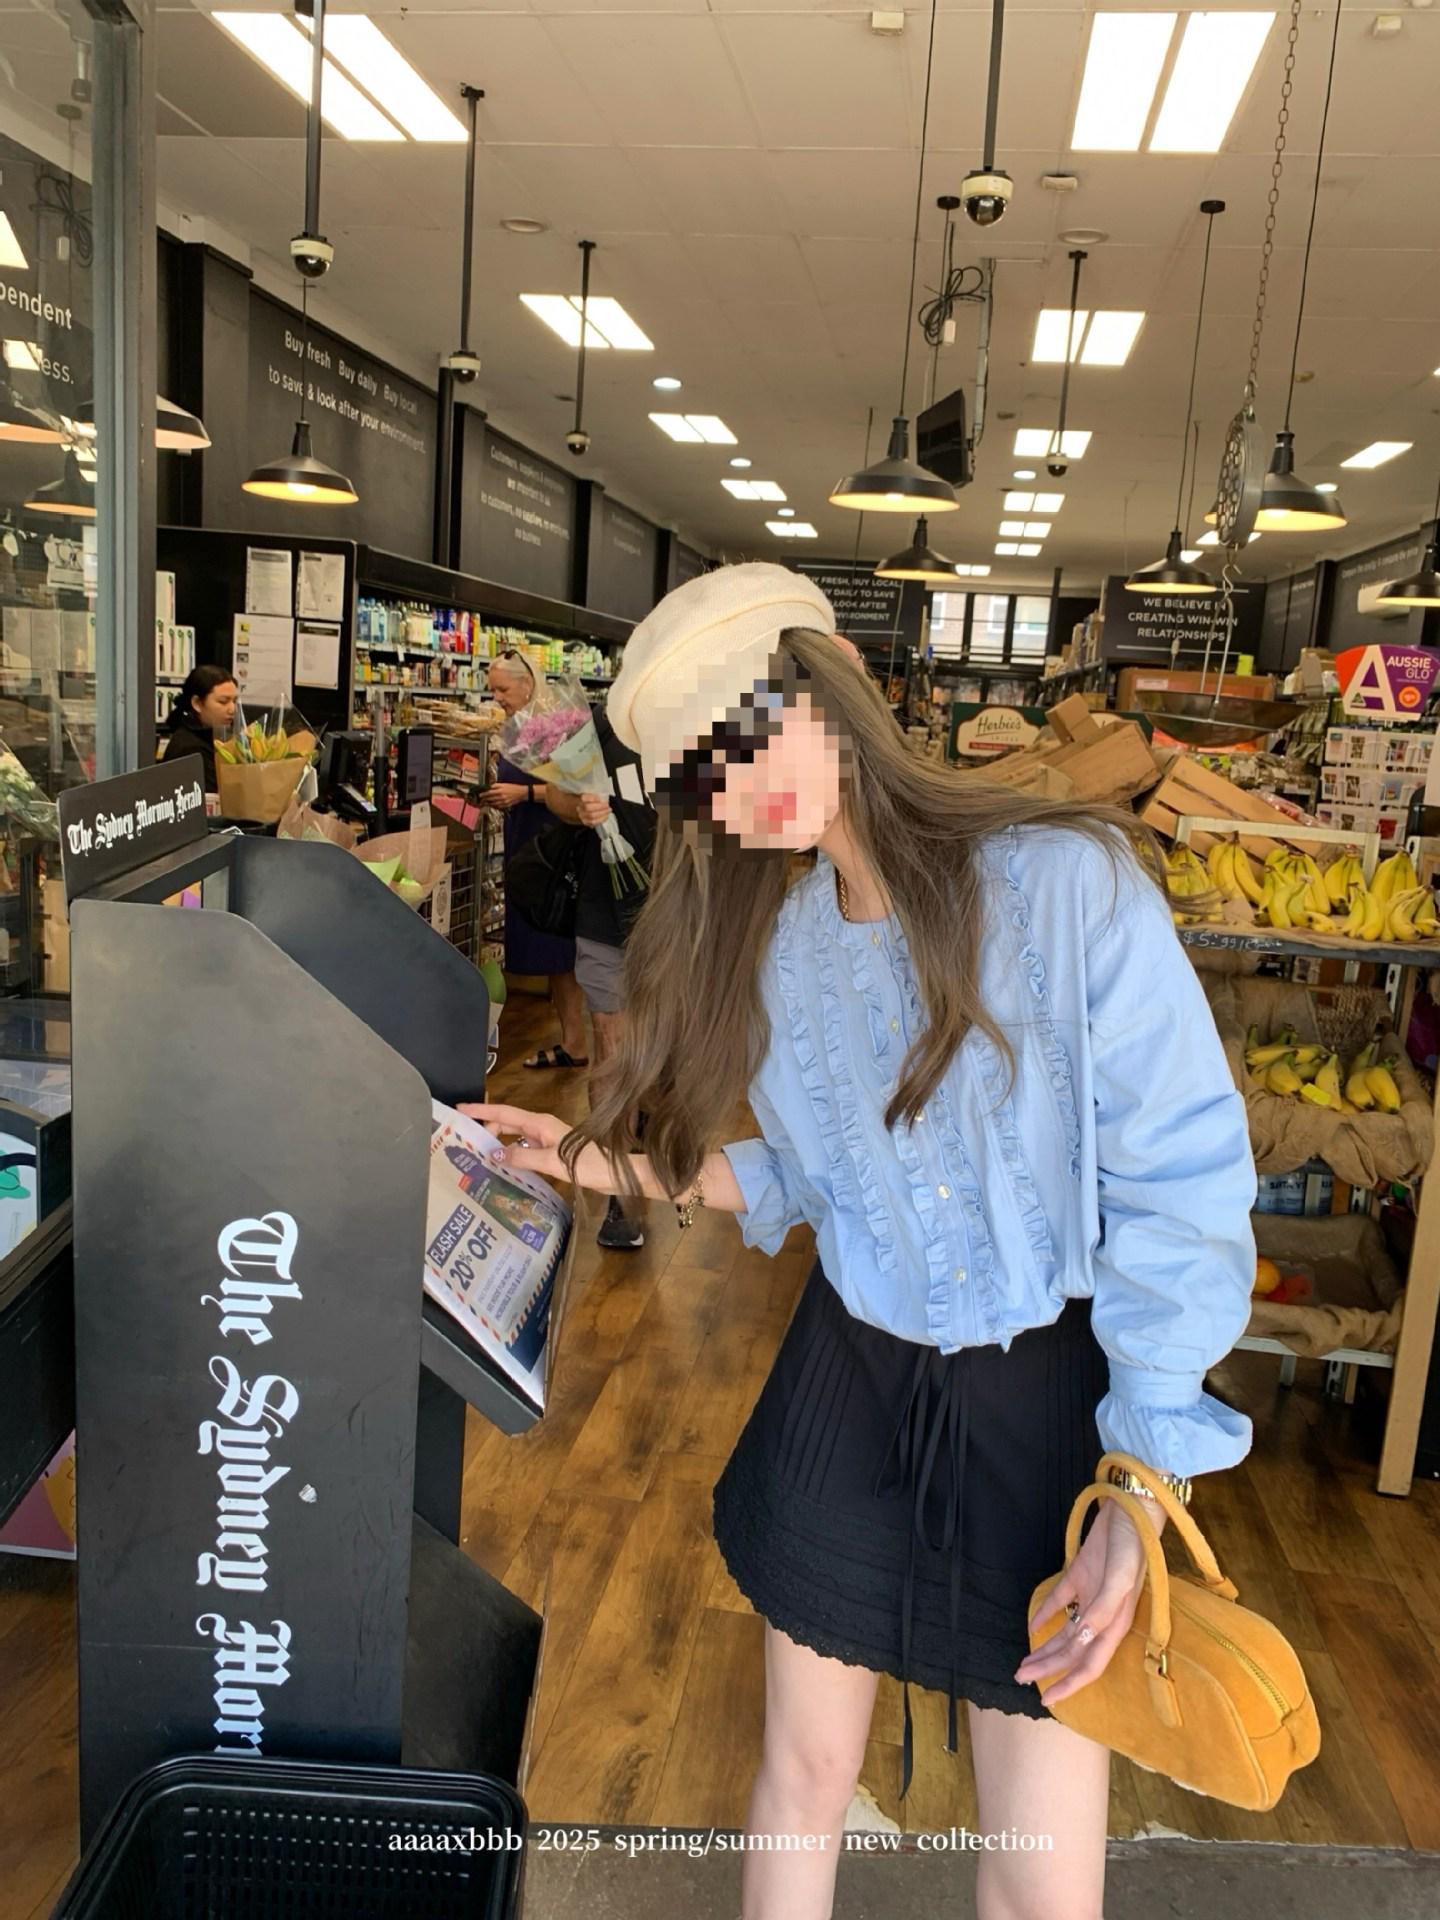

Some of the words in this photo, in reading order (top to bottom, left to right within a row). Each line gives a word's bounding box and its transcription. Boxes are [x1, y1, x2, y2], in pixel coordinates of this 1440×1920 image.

[284, 329, 304, 358] Buy
[307, 342, 332, 369] fresh
[338, 359, 356, 385] Buy
[357, 369, 378, 396] daily
[268, 364, 281, 385] to
[282, 374, 304, 398] save
[307, 383, 314, 402] &
[316, 386, 337, 412] look
[338, 399, 360, 422] after
[360, 411, 380, 432] your
[859, 601, 888, 609] AFTER
[873, 590, 896, 599] SAVE
[1143, 597, 1162, 607] WE
[1165, 598, 1212, 610] BELIEVE
[1127, 611, 1185, 624] CREATING
[1187, 614, 1239, 627] WIN-WIN
[1137, 627, 1226, 642] RELATIONSHIPS
[1386, 655, 1432, 669] AUSSIE
[1405, 667, 1430, 680] GLO
[977, 714, 1022, 736] Herbie's
[67, 817, 93, 857] The
[94, 809, 134, 850] Sydney
[135, 795, 175, 837] Morning
[174, 780, 203, 823] Herald
[431, 1229, 457, 1265] FLASH
[449, 1205, 473, 1236] SALE
[449, 1250, 475, 1291] 20%
[467, 1220, 498, 1261] OFF
[201, 1211, 302, 1347] The
[196, 1355, 301, 1594] Sydney
